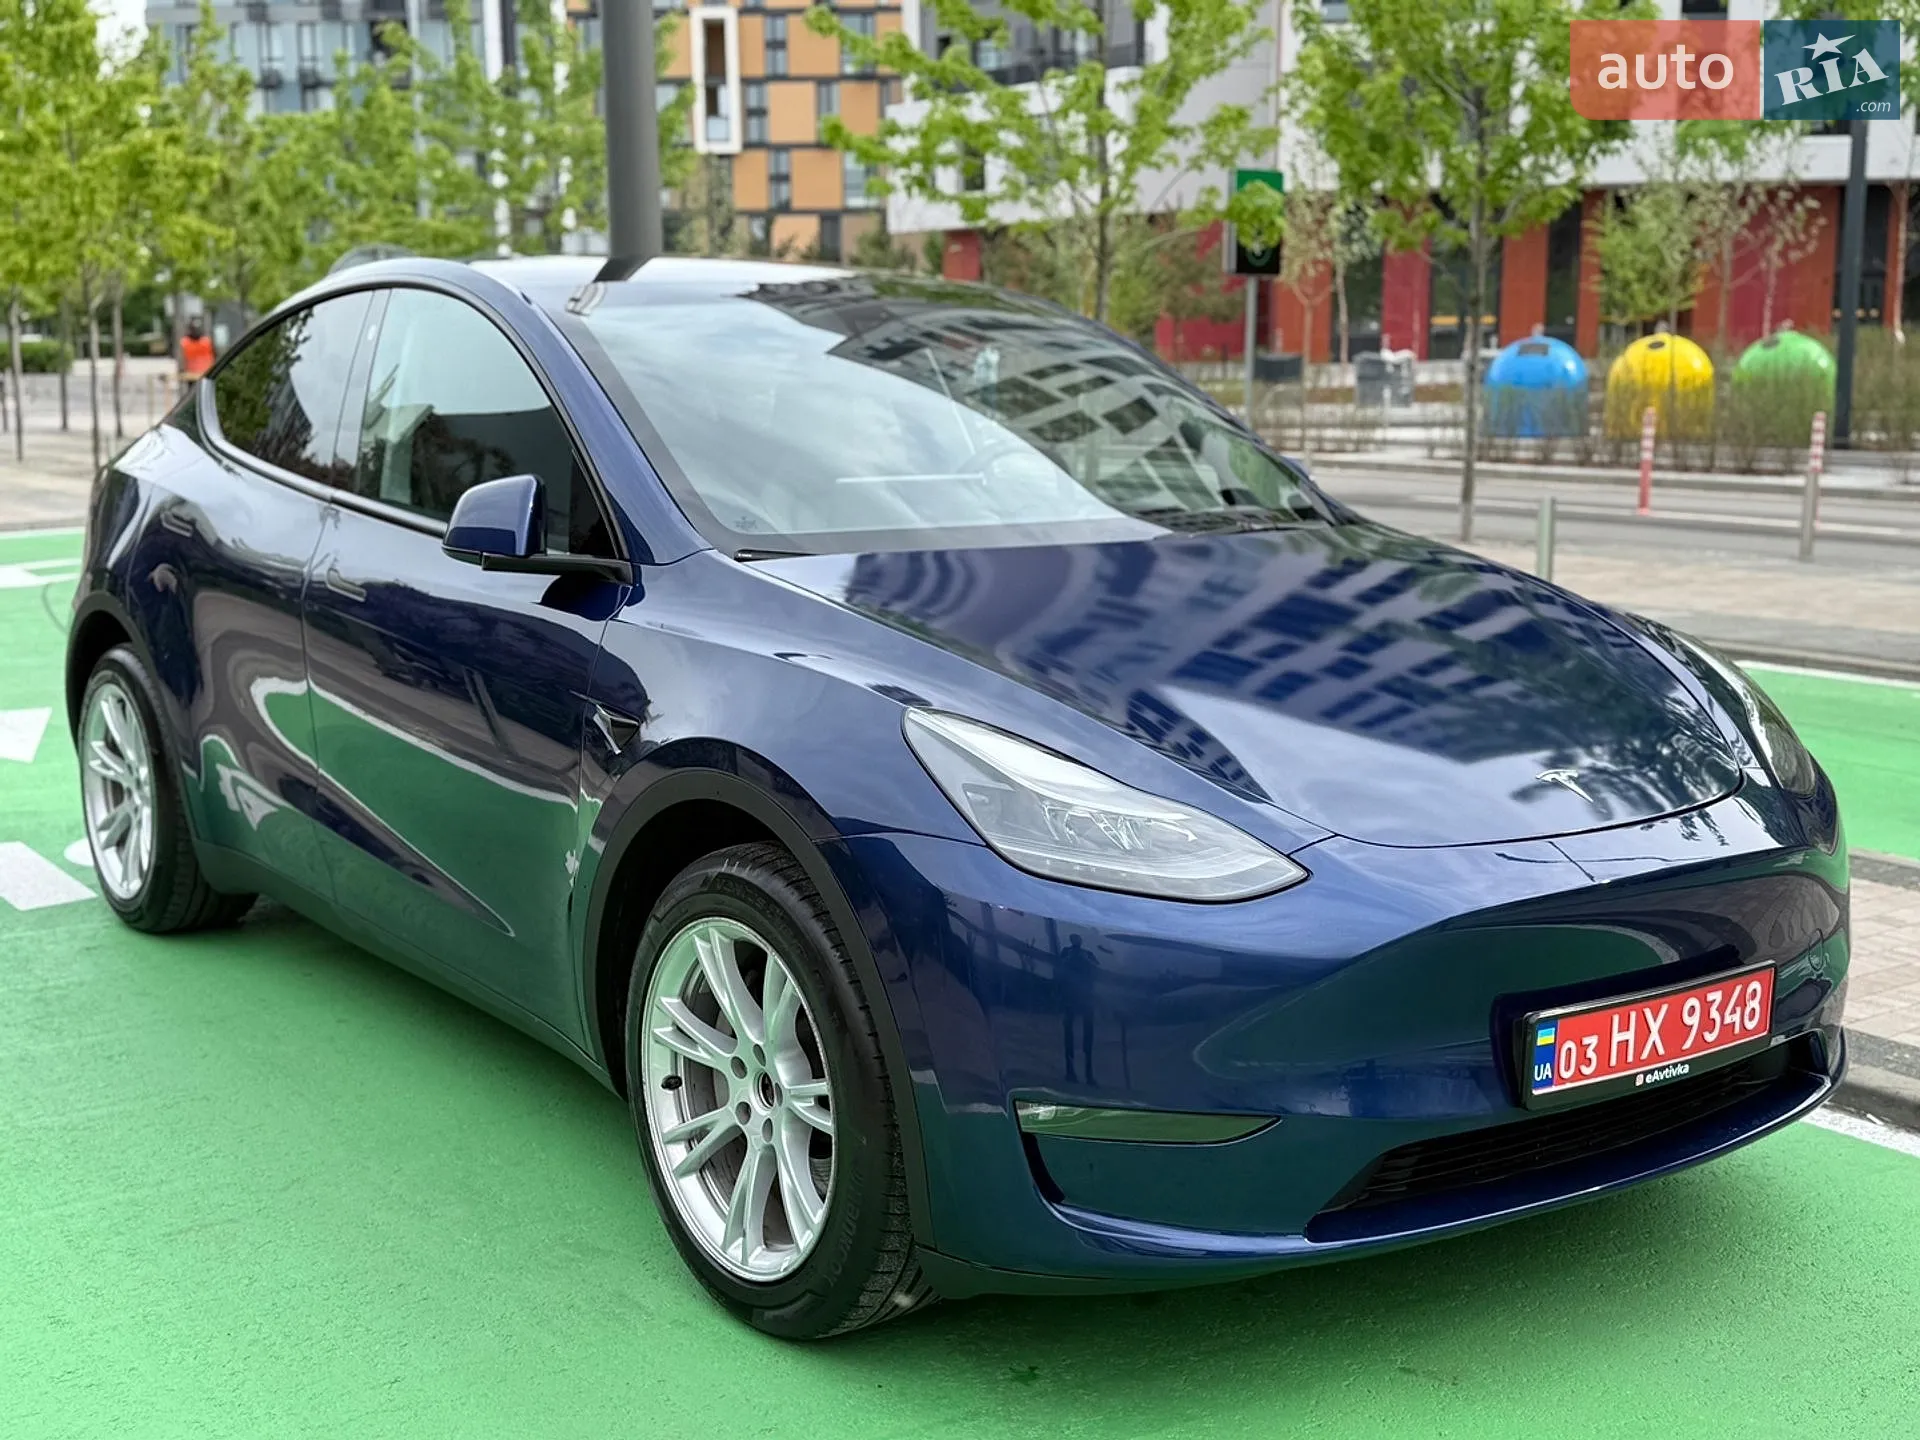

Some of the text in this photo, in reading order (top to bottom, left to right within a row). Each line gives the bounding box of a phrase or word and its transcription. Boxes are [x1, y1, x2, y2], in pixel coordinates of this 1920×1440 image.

[1558, 980, 1762, 1080] 03 HX 9348
[1534, 1062, 1552, 1082] UA
[1645, 1063, 1690, 1084] eAvtivka
